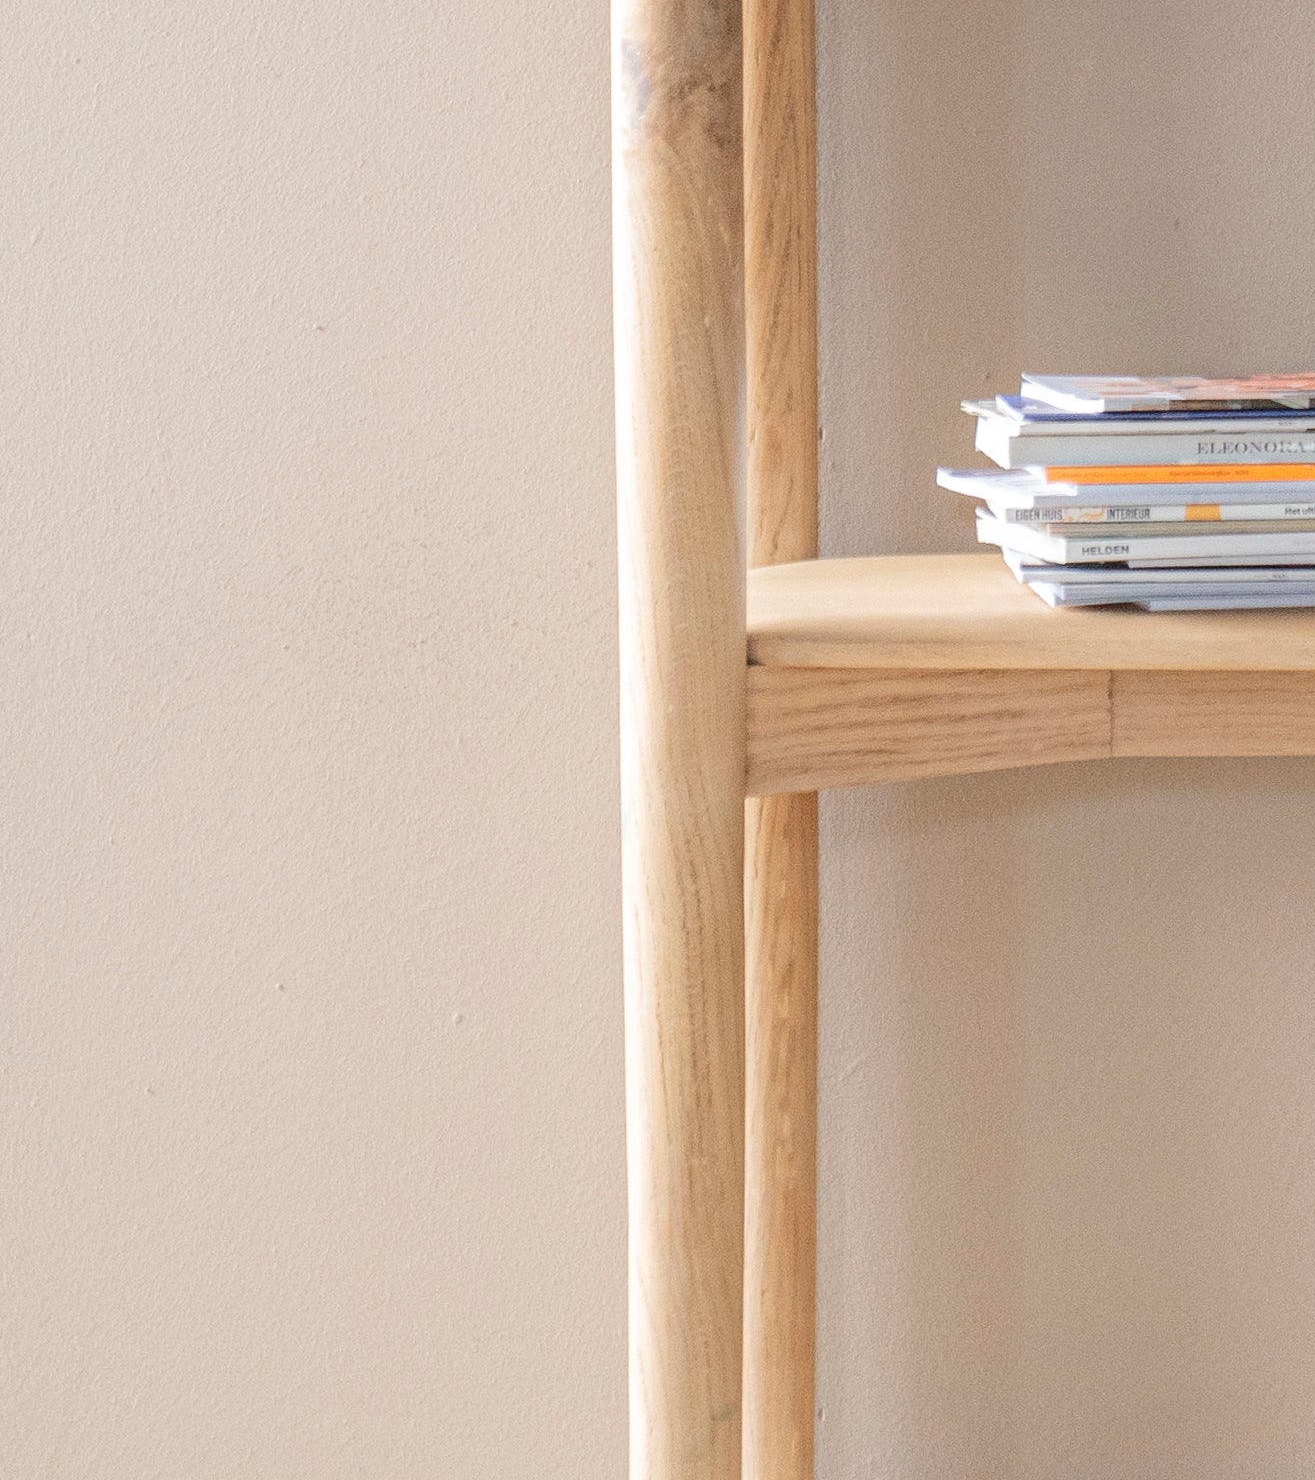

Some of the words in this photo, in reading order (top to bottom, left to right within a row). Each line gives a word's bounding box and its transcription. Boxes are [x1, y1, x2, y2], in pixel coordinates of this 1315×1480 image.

[1196, 441, 1307, 455] ELEONORA
[1015, 509, 1040, 522] EIGEN
[1041, 508, 1063, 521] HUIS
[1106, 508, 1151, 520] INTERIEUR
[1284, 507, 1301, 516] Het
[1081, 545, 1130, 557] HELDEN
